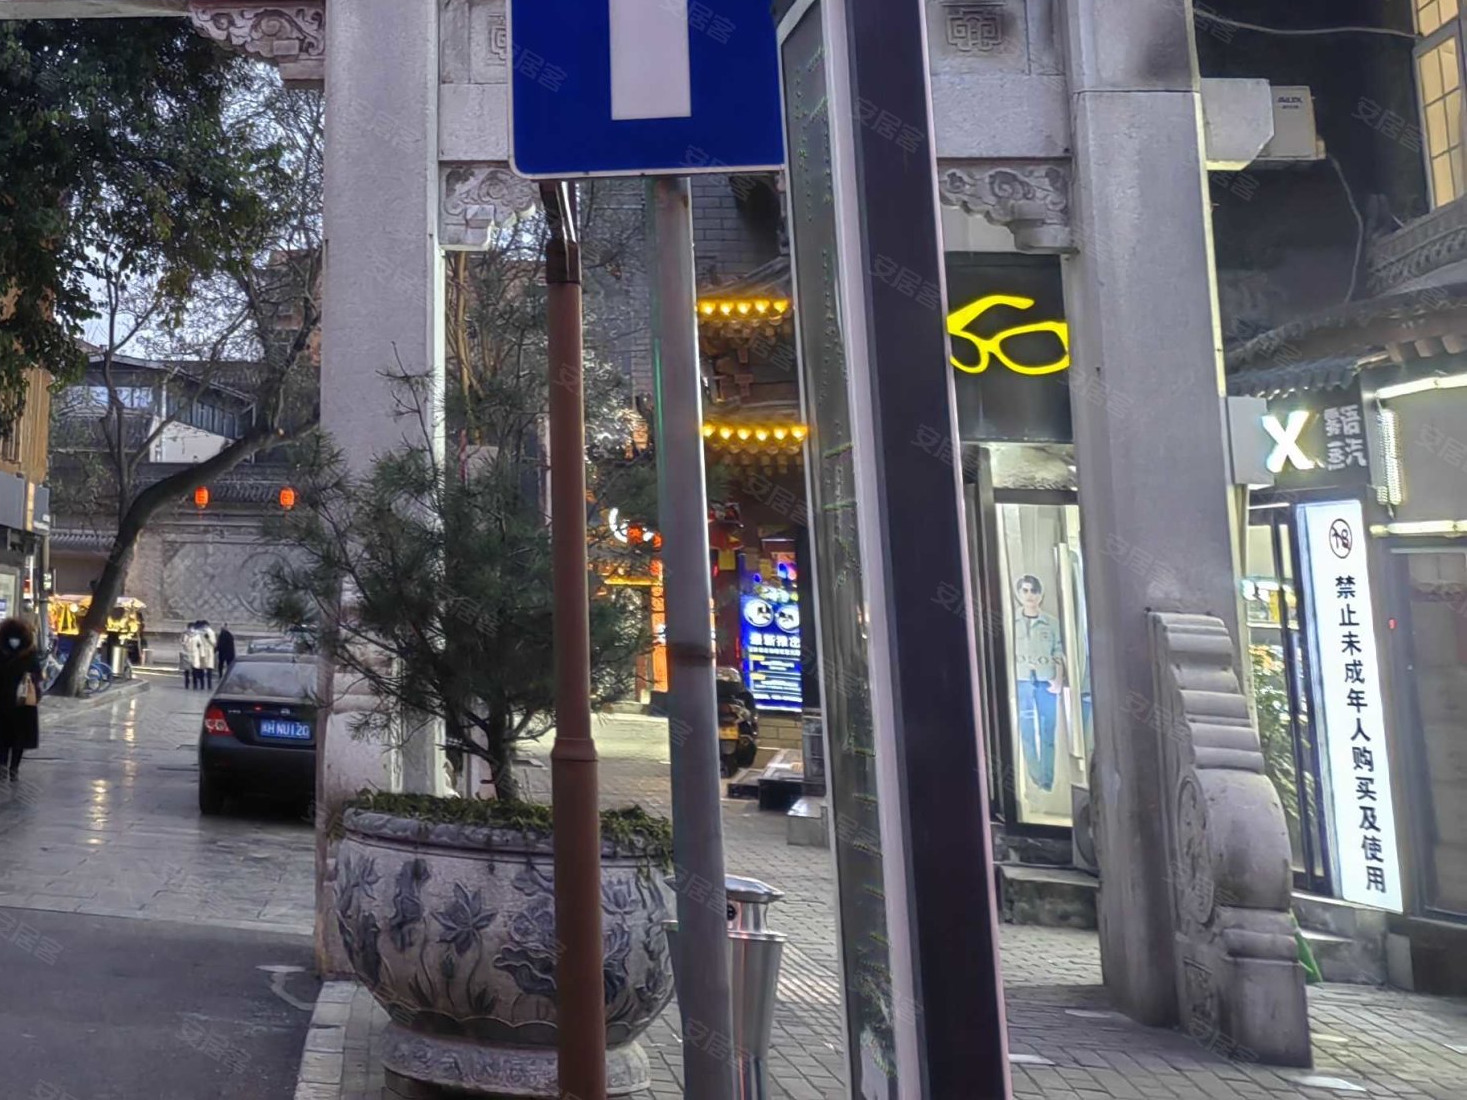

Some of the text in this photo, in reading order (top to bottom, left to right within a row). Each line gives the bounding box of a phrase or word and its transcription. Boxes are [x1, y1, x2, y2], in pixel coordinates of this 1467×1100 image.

[1334, 575, 1387, 894] 禁止未成年人购买及使用
